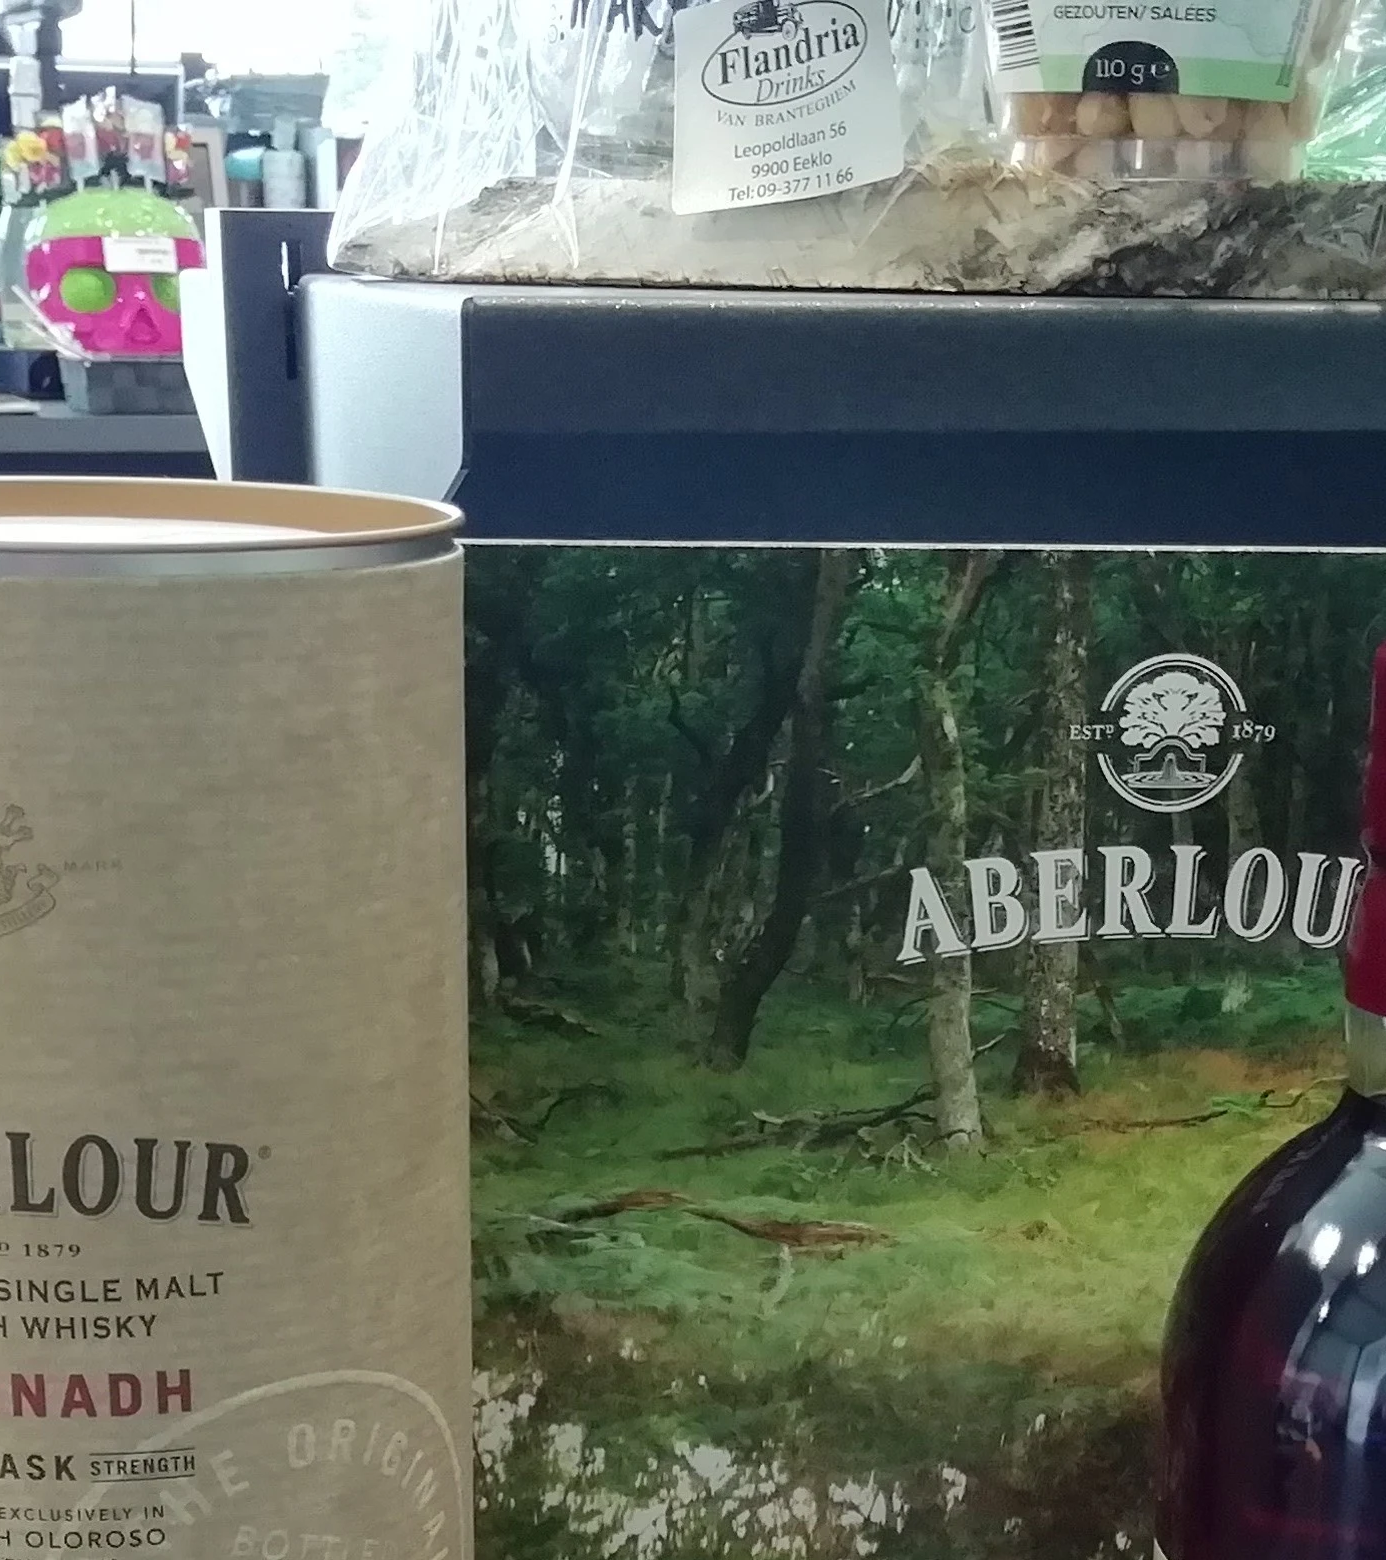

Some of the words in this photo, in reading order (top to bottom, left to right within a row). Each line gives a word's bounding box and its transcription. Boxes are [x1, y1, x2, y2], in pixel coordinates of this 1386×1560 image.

[717, 16, 861, 85] Flandria
[1095, 58, 1125, 78] 110
[754, 63, 826, 102] Drinks
[716, 109, 747, 127] VAN
[754, 79, 858, 127] BRANTEGHEM
[733, 129, 827, 161] Leopoldlaan
[829, 120, 847, 141] 56
[751, 159, 790, 178] 9900
[793, 151, 833, 173] Eeklo
[729, 185, 754, 202] Tel:
[756, 175, 811, 198] 09-377
[816, 172, 833, 191] 11
[834, 167, 854, 185] 66
[1231, 722, 1277, 743] 1879
[895, 845, 1365, 966] ABERLOU
[23, 1242, 82, 1258] 1879
[135, 1272, 225, 1302] MALT
[21, 1314, 158, 1340] WHISKY
[90, 1454, 196, 1477] STRENGTH
[144, 1504, 164, 1519] IN
[25, 1528, 166, 1549] OLOROSO
